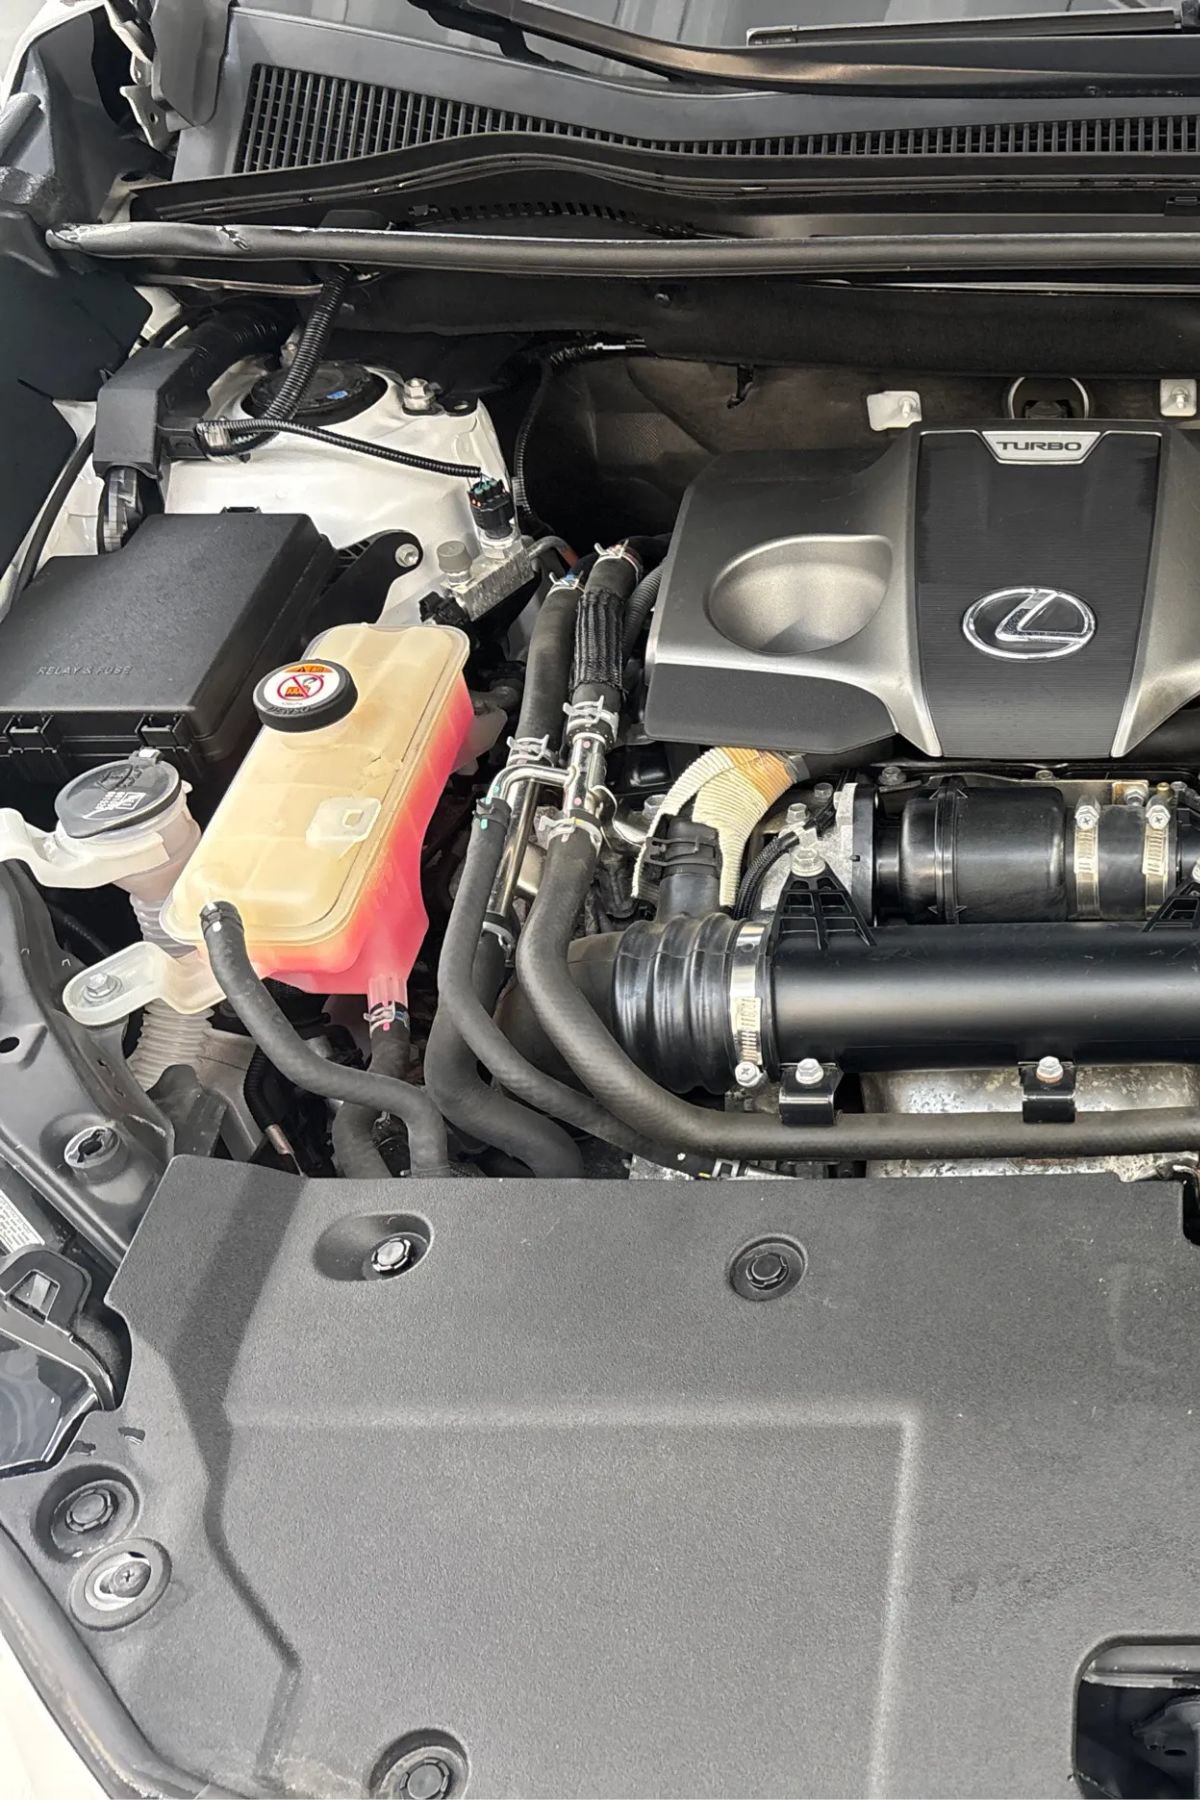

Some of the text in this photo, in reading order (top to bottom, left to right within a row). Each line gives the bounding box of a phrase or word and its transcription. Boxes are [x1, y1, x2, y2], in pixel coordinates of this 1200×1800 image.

[996, 441, 1082, 451] TURBO
[36, 665, 81, 675] RELAY
[96, 665, 133, 676] FUSE
